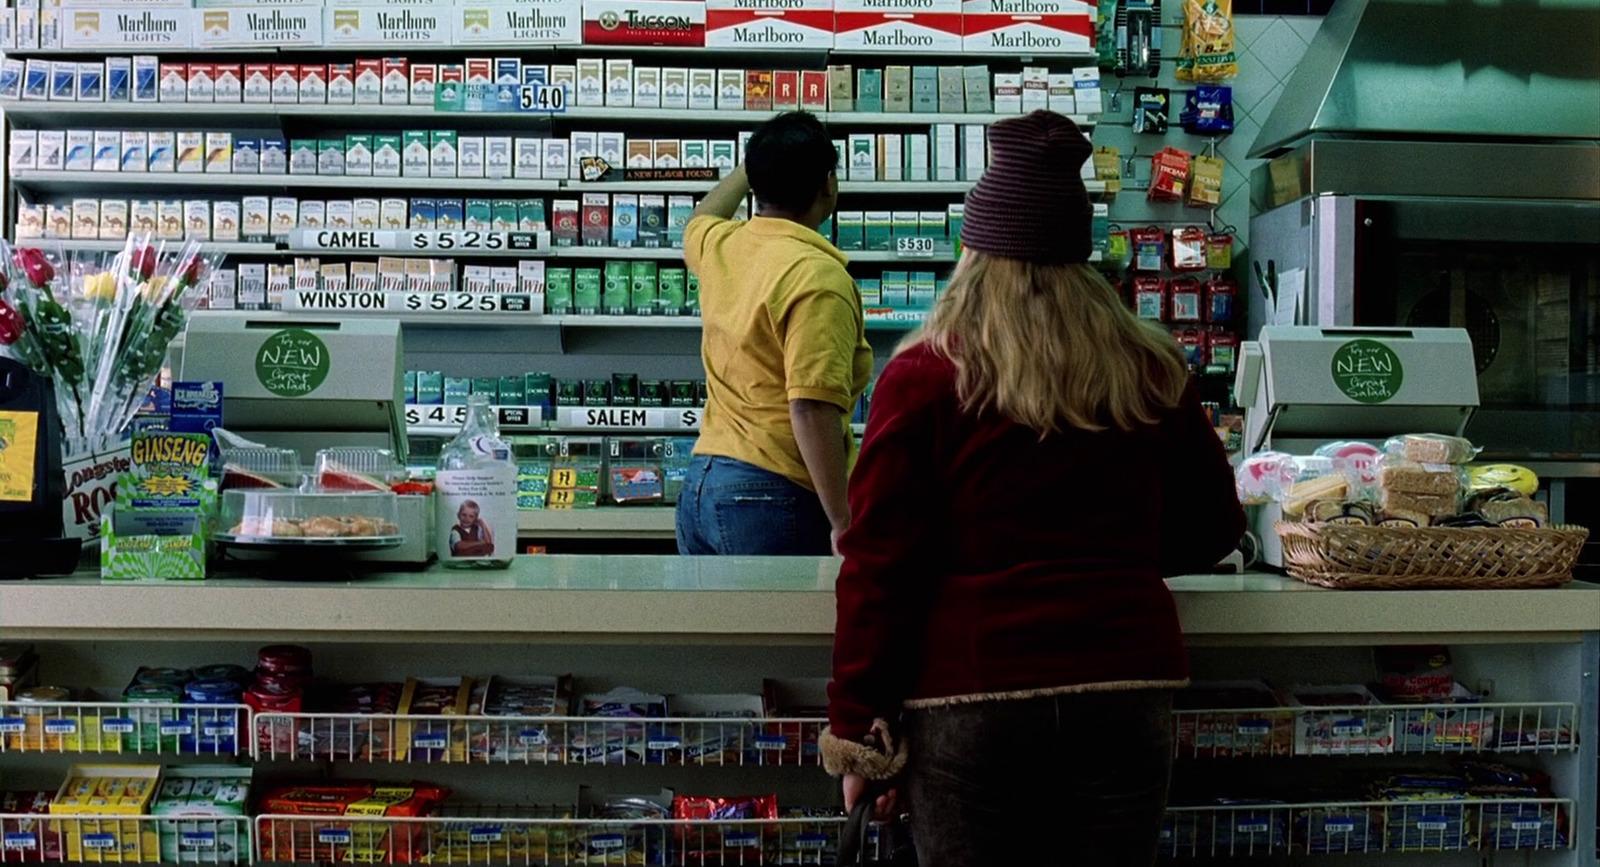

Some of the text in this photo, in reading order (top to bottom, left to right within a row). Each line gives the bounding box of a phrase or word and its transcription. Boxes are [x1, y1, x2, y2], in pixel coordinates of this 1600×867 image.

[990, 0, 1059, 13] Marlboro
[117, 12, 177, 33] Marlboro
[247, 10, 306, 31] Marlboro
[377, 9, 436, 30] Marlboro
[506, 8, 566, 29] Marlboro
[123, 33, 171, 42] LIGHTS
[254, 32, 301, 41] LIGHTS
[383, 31, 431, 40] LIGHTS
[513, 30, 561, 39] LIGHTS
[734, 27, 804, 43] Marlboro
[863, 30, 933, 47] Marlboro
[991, 31, 1061, 48] Marlboro
[782, 83, 790, 97] R
[810, 84, 818, 97] R
[635, 171, 653, 179] NEW
[655, 170, 684, 178] FLAVOR
[686, 169, 713, 178] FOUND
[1159, 165, 1186, 179] TROJAN
[318, 231, 379, 248] CAMEL
[300, 292, 385, 309] WINSTON
[262, 345, 320, 367] NEW
[1337, 352, 1393, 373] NEW
[265, 379, 312, 391] Salads
[1346, 386, 1392, 397] Salads
[587, 409, 646, 426] SALEM
[133, 436, 207, 467] GINSENG
[611, 441, 619, 456] 7
[666, 442, 674, 457] 8
[367, 807, 384, 816] SIZE
